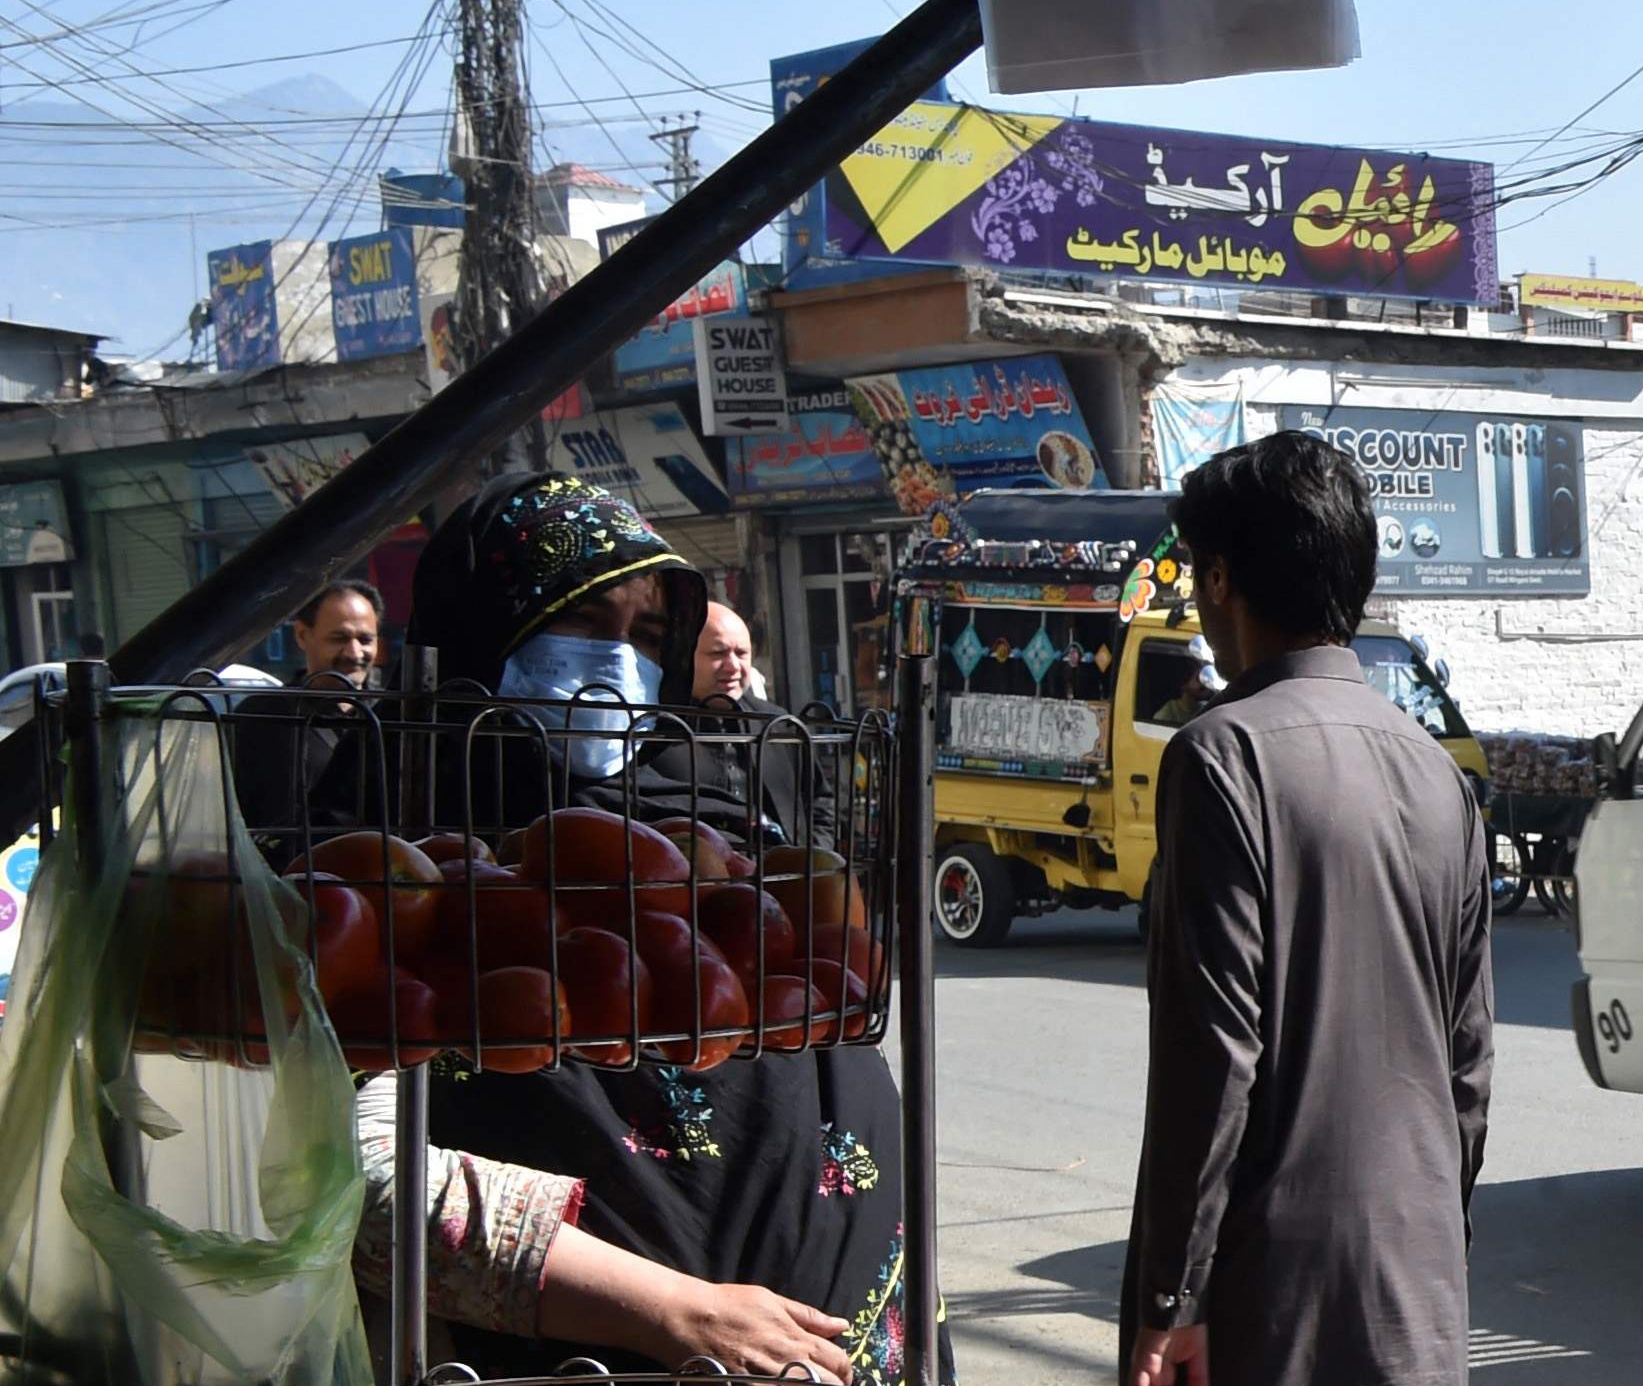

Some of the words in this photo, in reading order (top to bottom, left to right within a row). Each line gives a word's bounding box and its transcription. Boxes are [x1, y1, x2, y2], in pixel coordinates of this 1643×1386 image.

[350, 240, 393, 286] SWAT
[1066, 227, 1184, 275] مارکیٹ
[710, 327, 773, 350] SWAT
[714, 355, 774, 373] GUEST
[717, 377, 777, 394] HOUSE
[1362, 471, 1434, 498] OBILE
[1384, 499, 1457, 514] Accessories
[1597, 998, 1636, 1054] 90
